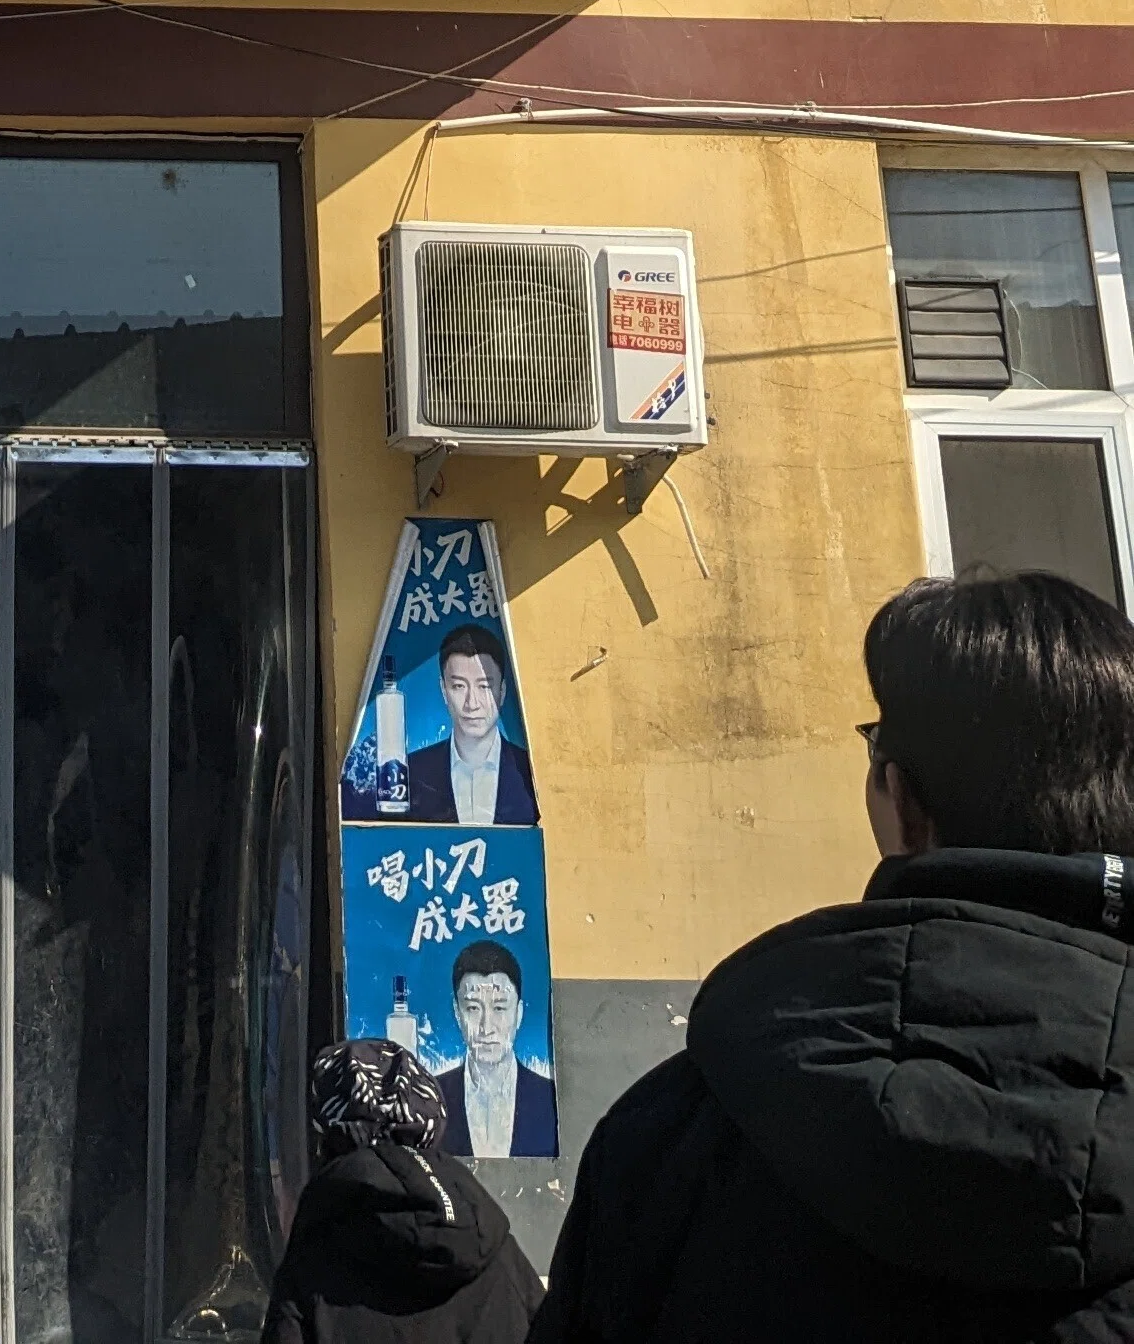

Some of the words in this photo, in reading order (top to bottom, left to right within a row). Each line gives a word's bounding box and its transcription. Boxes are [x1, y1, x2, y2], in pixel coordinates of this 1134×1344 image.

[635, 272, 675, 282] GREE
[613, 295, 680, 316] 幸福树
[398, 571, 500, 632] 成大器
[387, 768, 407, 800] 小刀
[367, 838, 487, 903] 喝小刀
[408, 877, 526, 951] 成大器
